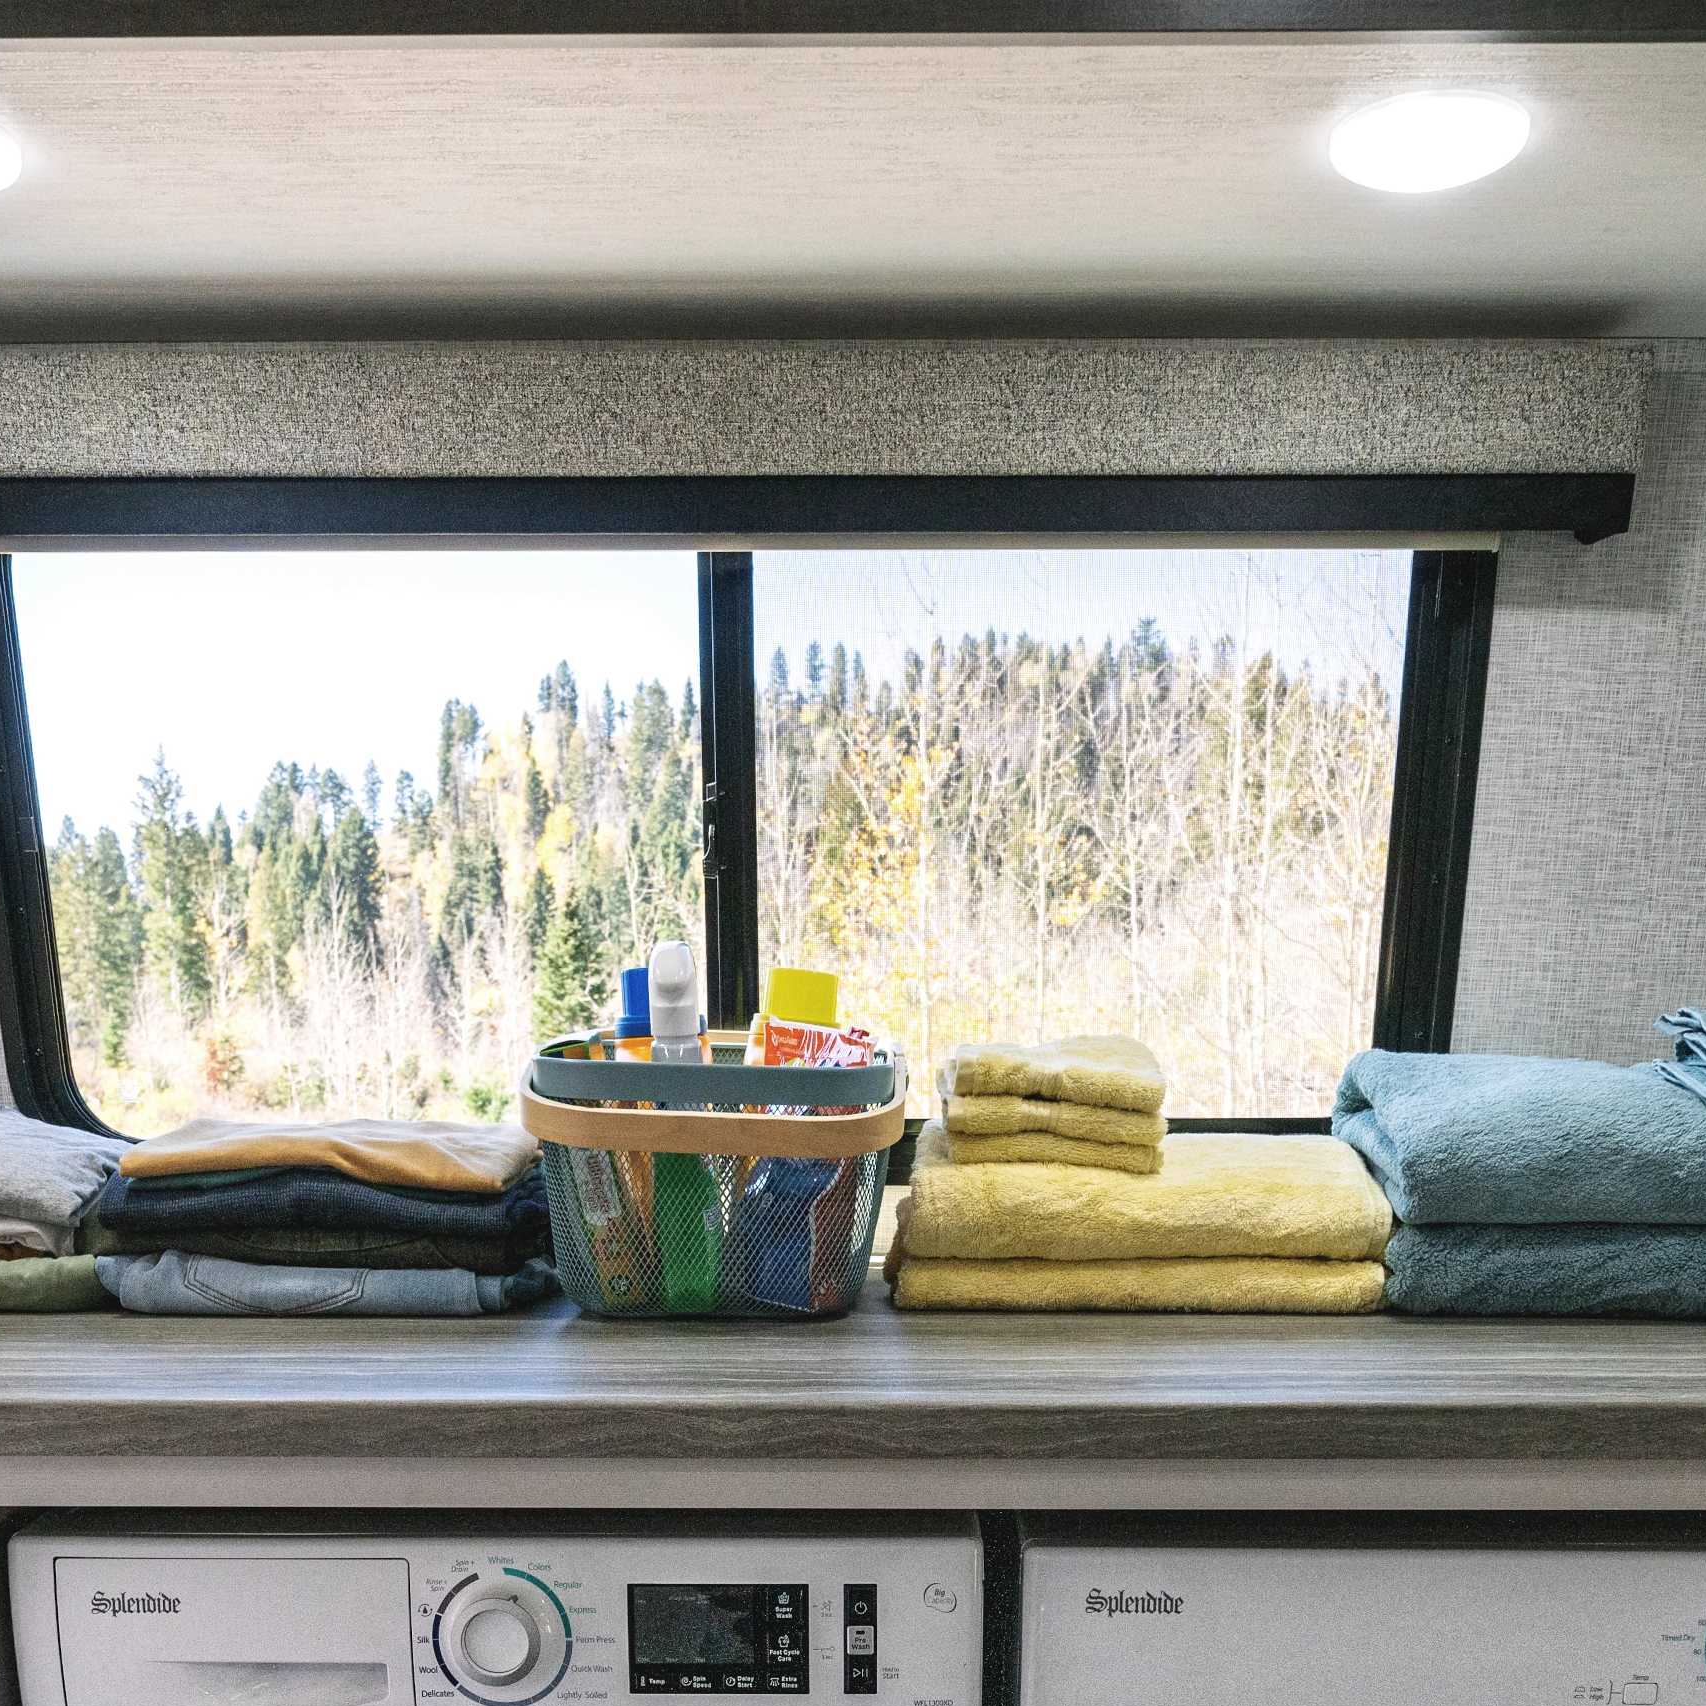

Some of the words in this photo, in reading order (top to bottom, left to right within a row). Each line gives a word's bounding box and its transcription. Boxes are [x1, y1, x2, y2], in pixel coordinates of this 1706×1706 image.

[488, 1556, 514, 1565] Whites
[528, 1562, 551, 1571] Colors
[554, 1580, 582, 1590] Regular
[91, 1590, 181, 1617] Splendide
[1085, 1588, 1184, 1618] Splendide
[569, 1606, 597, 1616] Express
[417, 1636, 429, 1644] Silk
[596, 1636, 616, 1644] Press
[419, 1666, 438, 1674] Wool
[571, 1664, 592, 1673] Quick
[593, 1664, 613, 1672] Wash
[421, 1690, 454, 1698] Delicates
[557, 1691, 582, 1700] Lightly
[585, 1691, 608, 1699] Soiled
